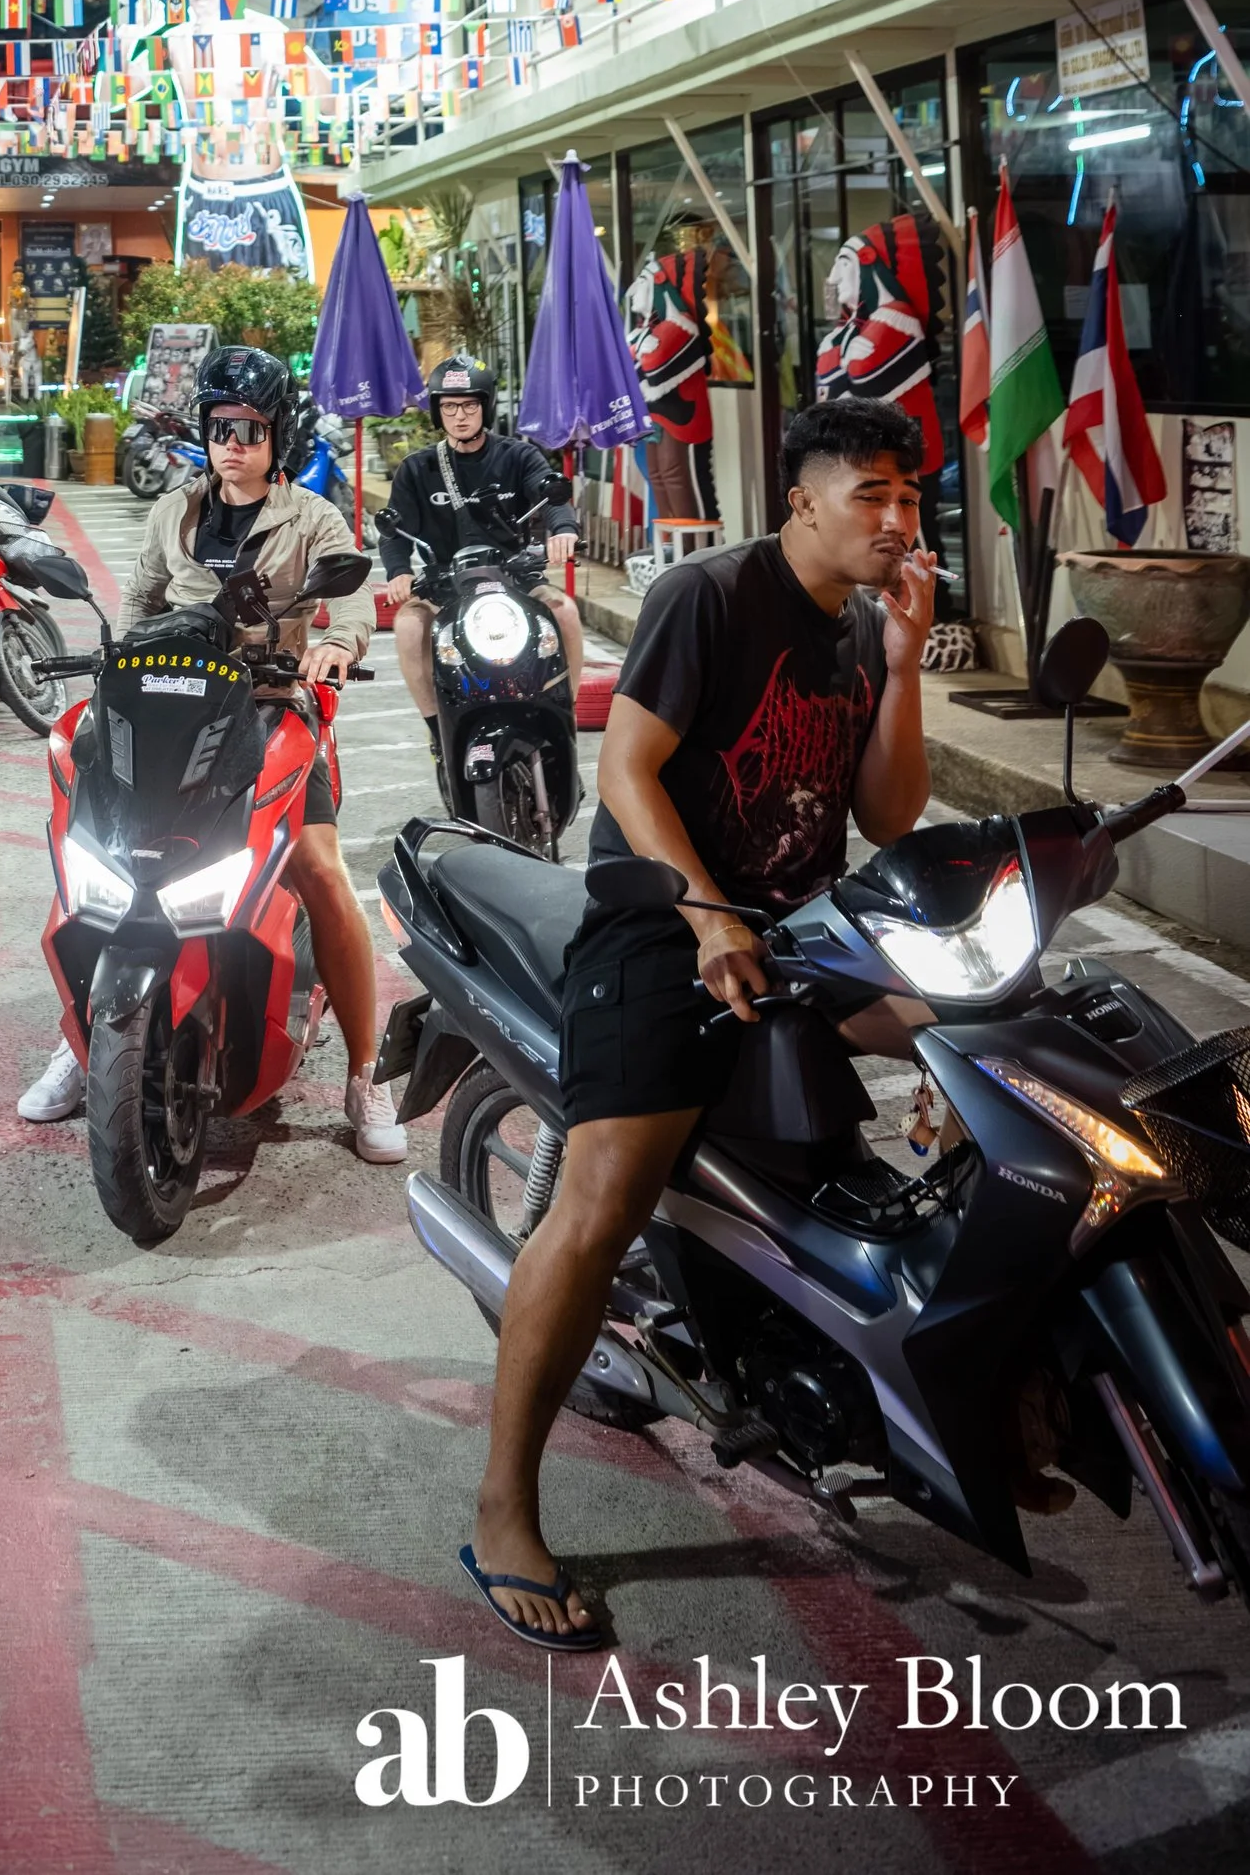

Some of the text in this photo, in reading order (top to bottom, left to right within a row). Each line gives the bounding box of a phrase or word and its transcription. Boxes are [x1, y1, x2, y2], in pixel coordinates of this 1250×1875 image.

[0, 158, 40, 173] GYM
[608, 394, 631, 412] SCB
[1084, 999, 1123, 1021] HONDA
[998, 1165, 1068, 1205] HONDA
